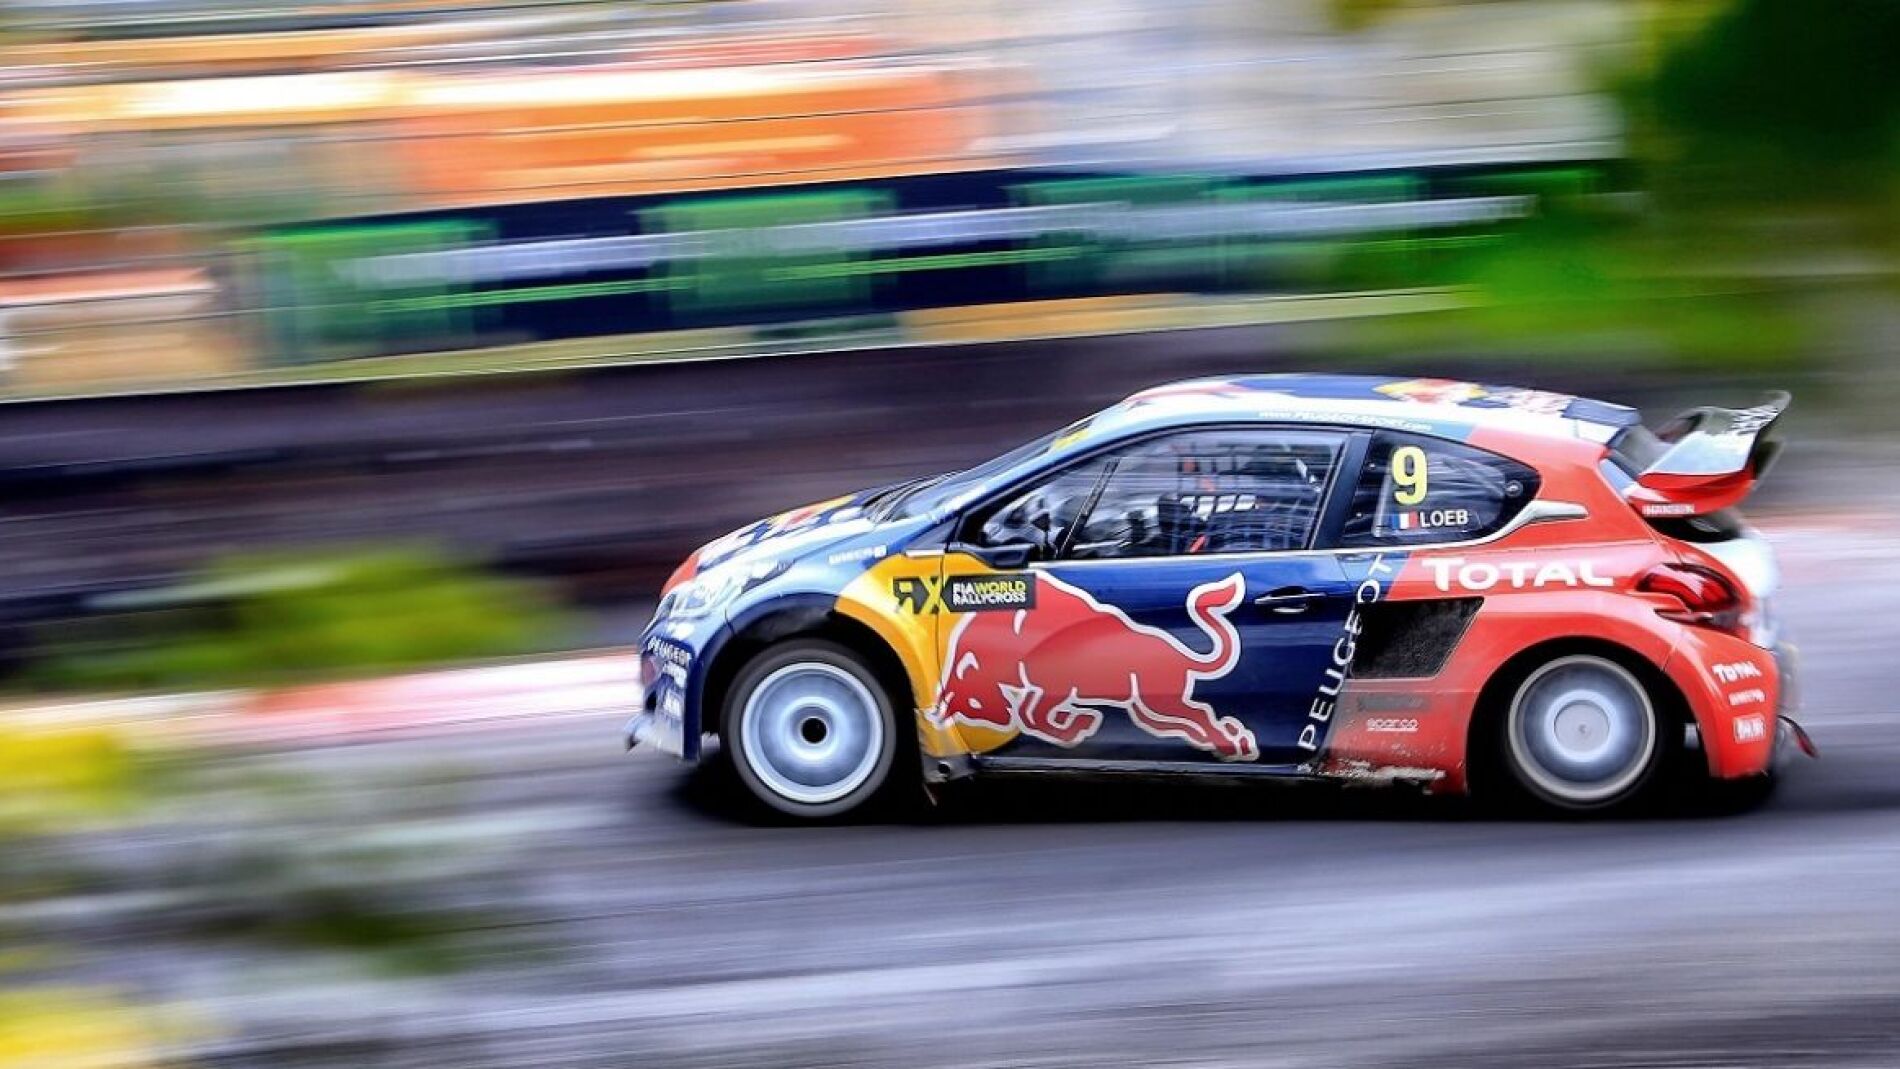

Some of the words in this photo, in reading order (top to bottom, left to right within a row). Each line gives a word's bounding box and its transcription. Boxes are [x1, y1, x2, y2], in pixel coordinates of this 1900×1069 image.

[1392, 446, 1428, 505] 9
[1420, 509, 1469, 527] LOEB
[1421, 557, 1614, 591] TOTAL
[952, 591, 1027, 605] RALLYCROSS
[1298, 553, 1393, 750] PEUGEOT
